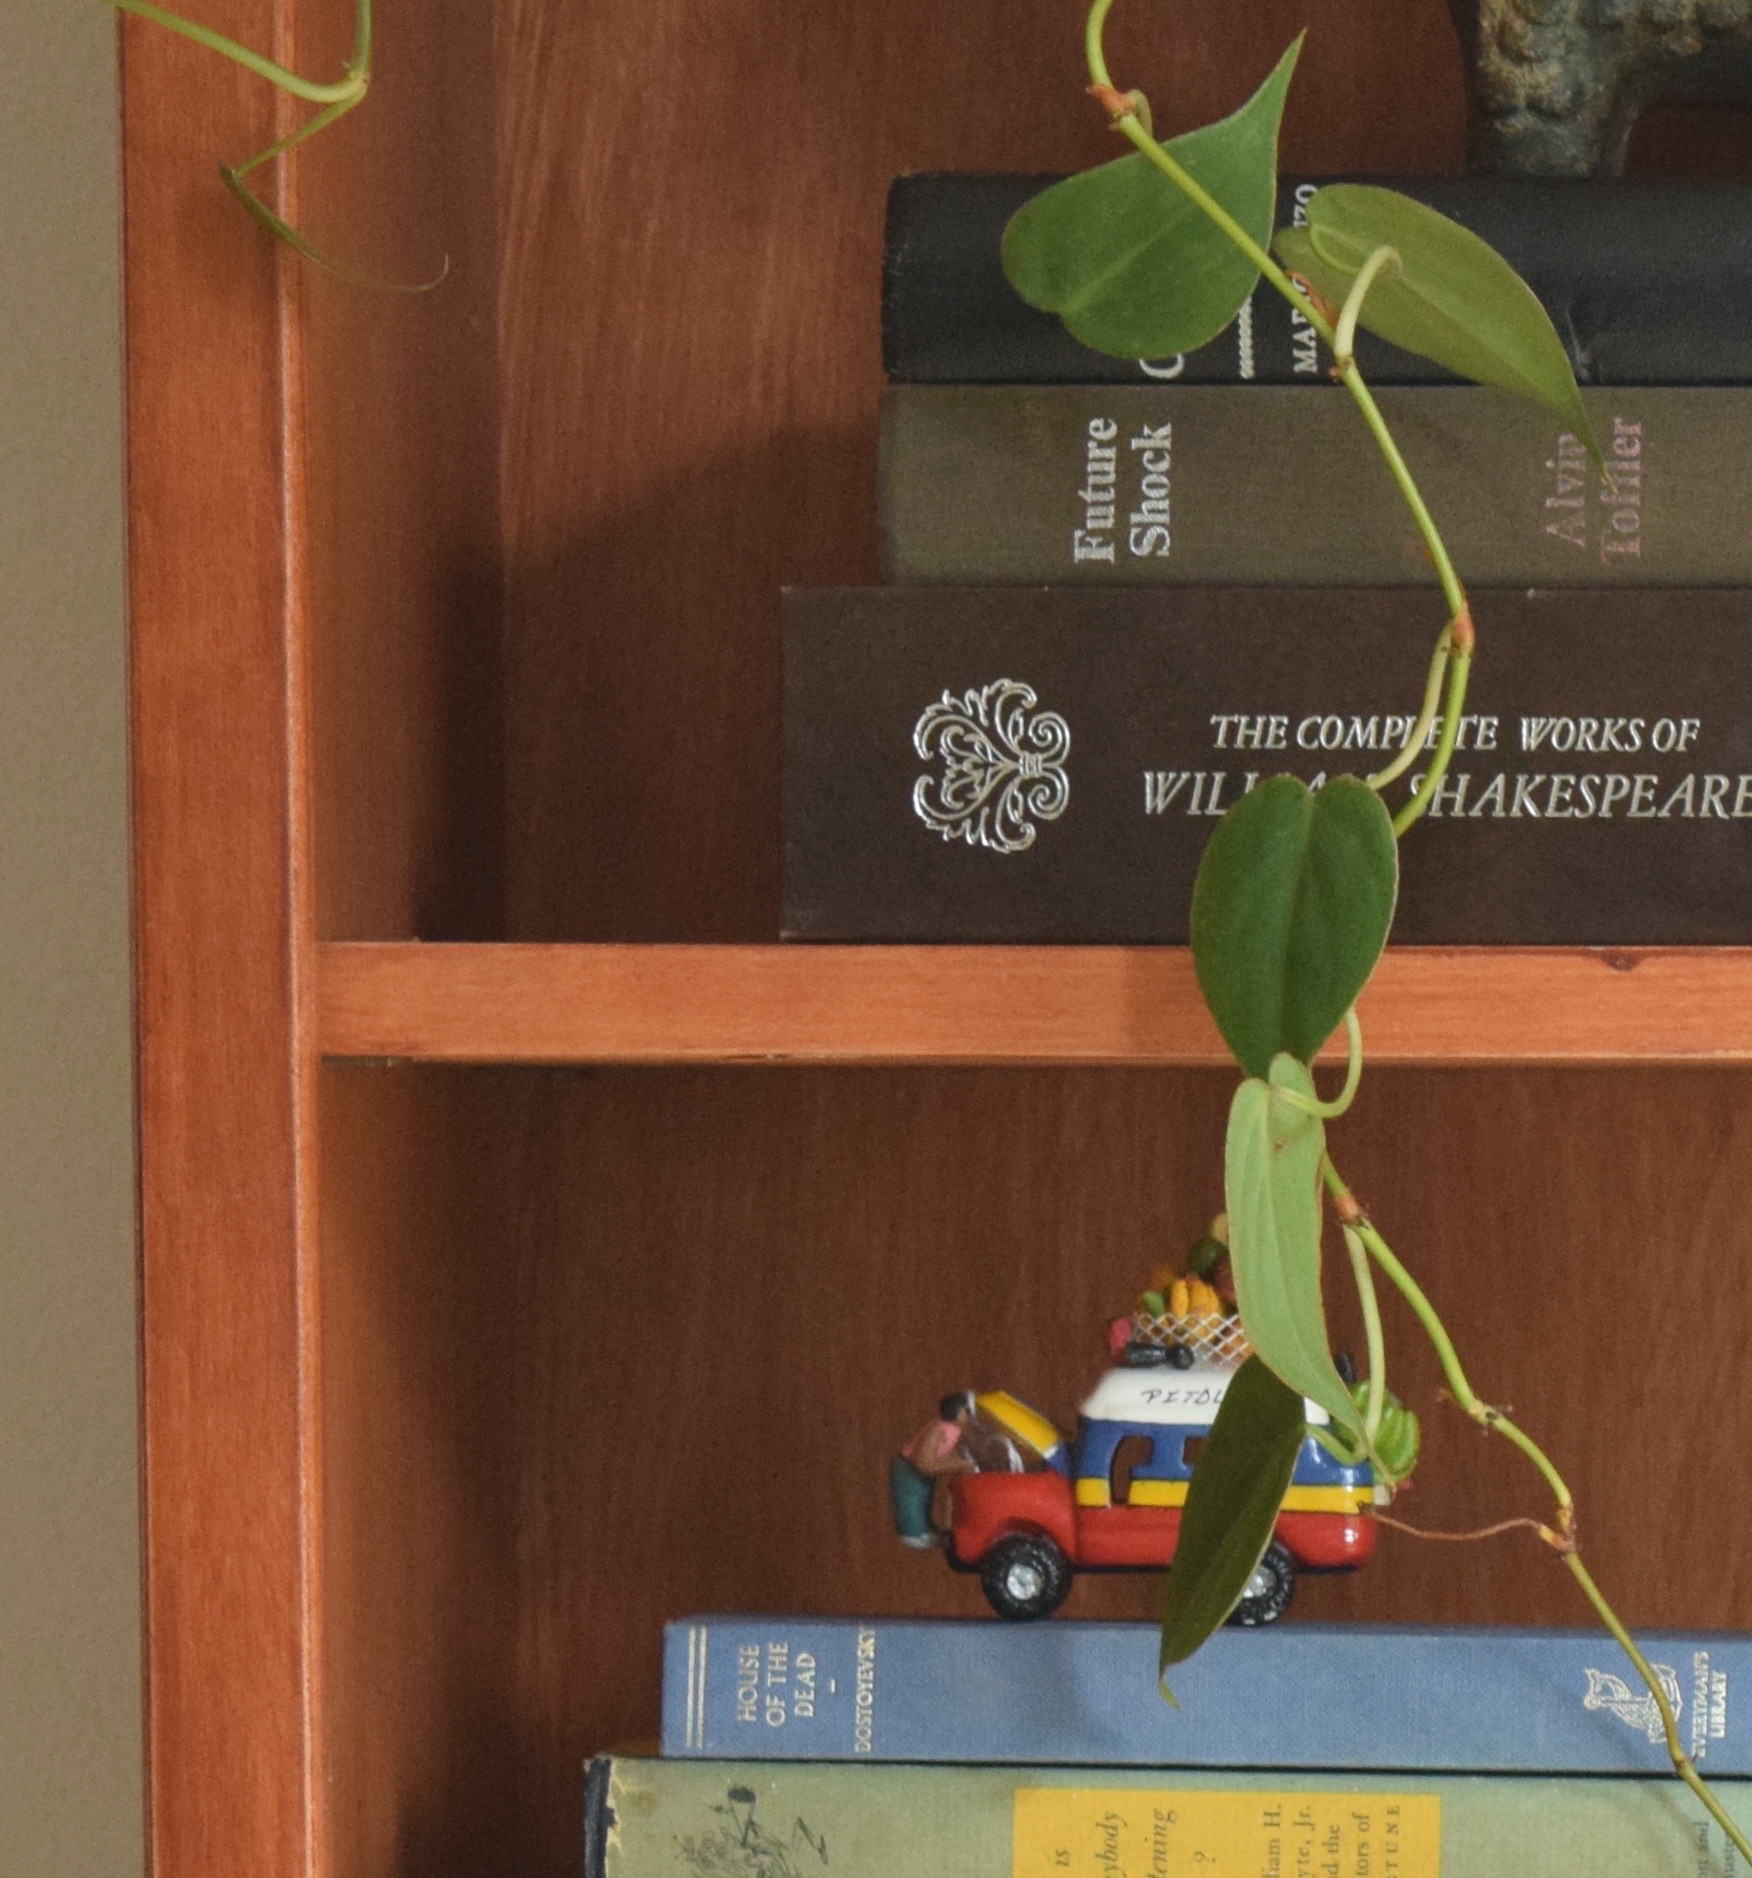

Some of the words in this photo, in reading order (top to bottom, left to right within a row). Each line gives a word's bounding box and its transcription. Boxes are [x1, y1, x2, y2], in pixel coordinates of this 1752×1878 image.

[1073, 417, 1118, 565] Future
[1129, 421, 1173, 557] Shock
[1544, 431, 1587, 548] Alvin
[1210, 714, 1290, 750] THE
[1520, 715, 1646, 752] WORKS
[1651, 716, 1701, 752] OF
[737, 1643, 761, 1723] HOUSE
[767, 1641, 790, 1687] THE
[794, 1652, 817, 1718] DEAD
[766, 1693, 787, 1728] OF
[1710, 1669, 1728, 1739] LIBRARY
[1263, 1803, 1283, 1830] H.
[1292, 1805, 1315, 1831] Jr.
[1348, 1811, 1372, 1833] of
[1047, 1847, 1071, 1868] is
[1321, 1822, 1342, 1858] the
